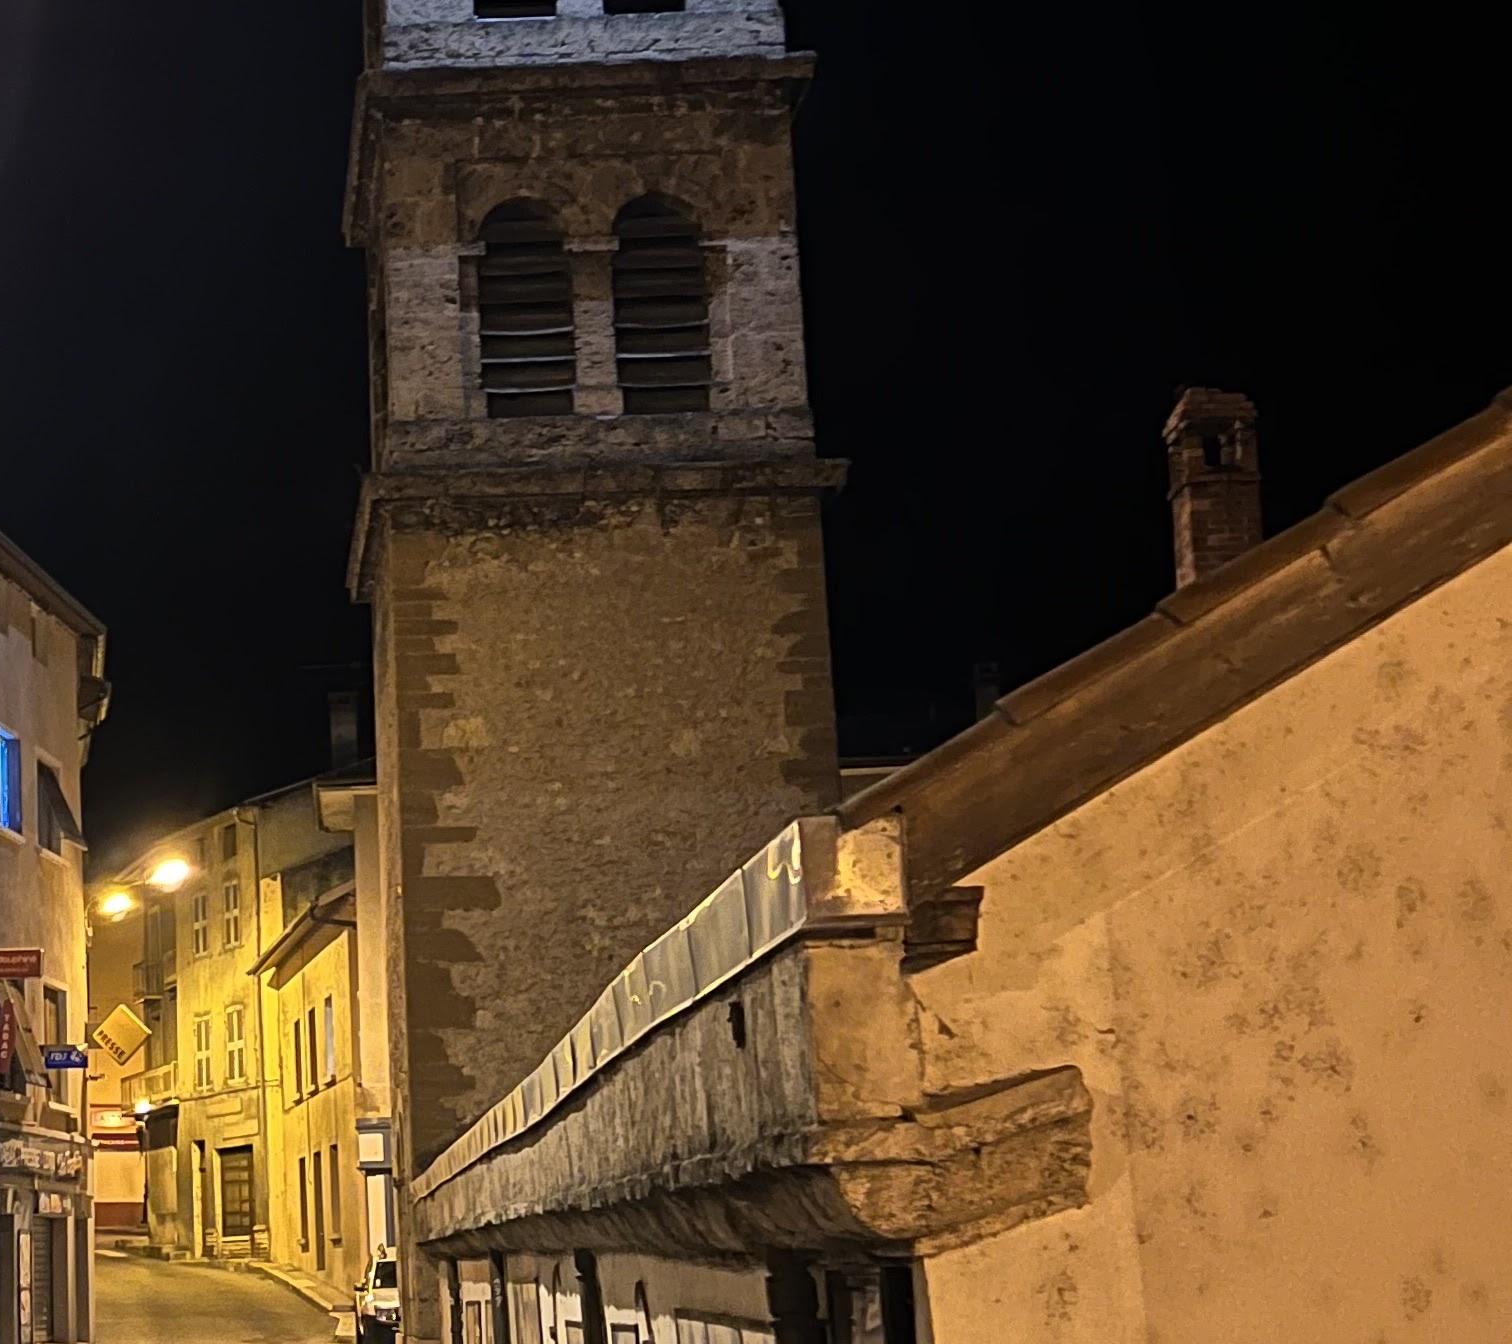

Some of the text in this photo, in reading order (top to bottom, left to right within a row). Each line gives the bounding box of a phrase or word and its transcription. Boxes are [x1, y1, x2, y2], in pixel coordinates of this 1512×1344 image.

[0, 1013, 10, 1059] TABAC
[97, 1029, 126, 1060] PRESSE
[50, 1052, 68, 1061] FDJ
